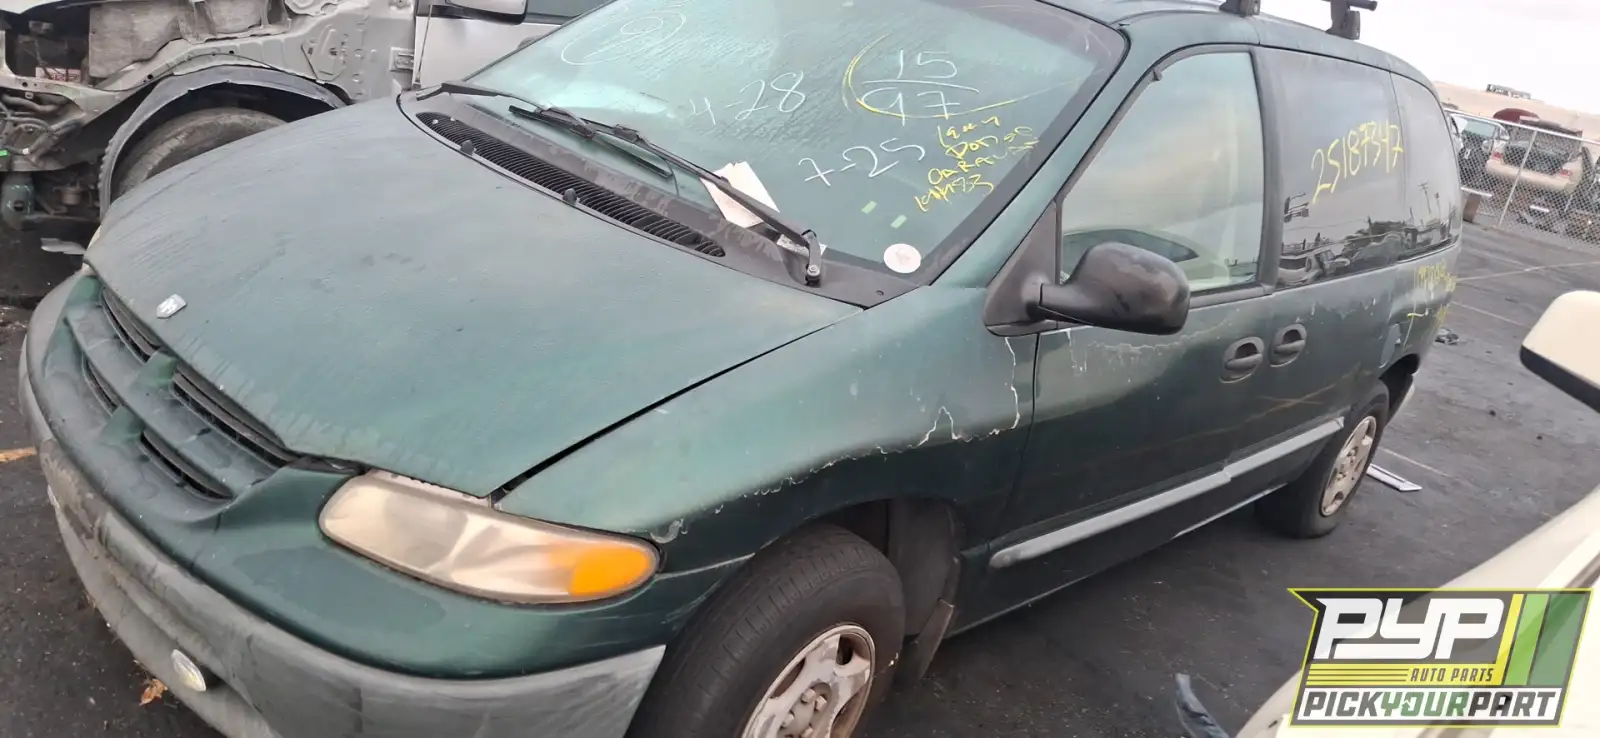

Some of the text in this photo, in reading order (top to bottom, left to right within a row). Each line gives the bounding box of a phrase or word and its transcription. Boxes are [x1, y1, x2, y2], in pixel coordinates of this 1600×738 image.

[896, 50, 958, 80] 15
[689, 70, 807, 126] 4-28
[862, 87, 961, 126] 97
[799, 138, 926, 187] 7-25
